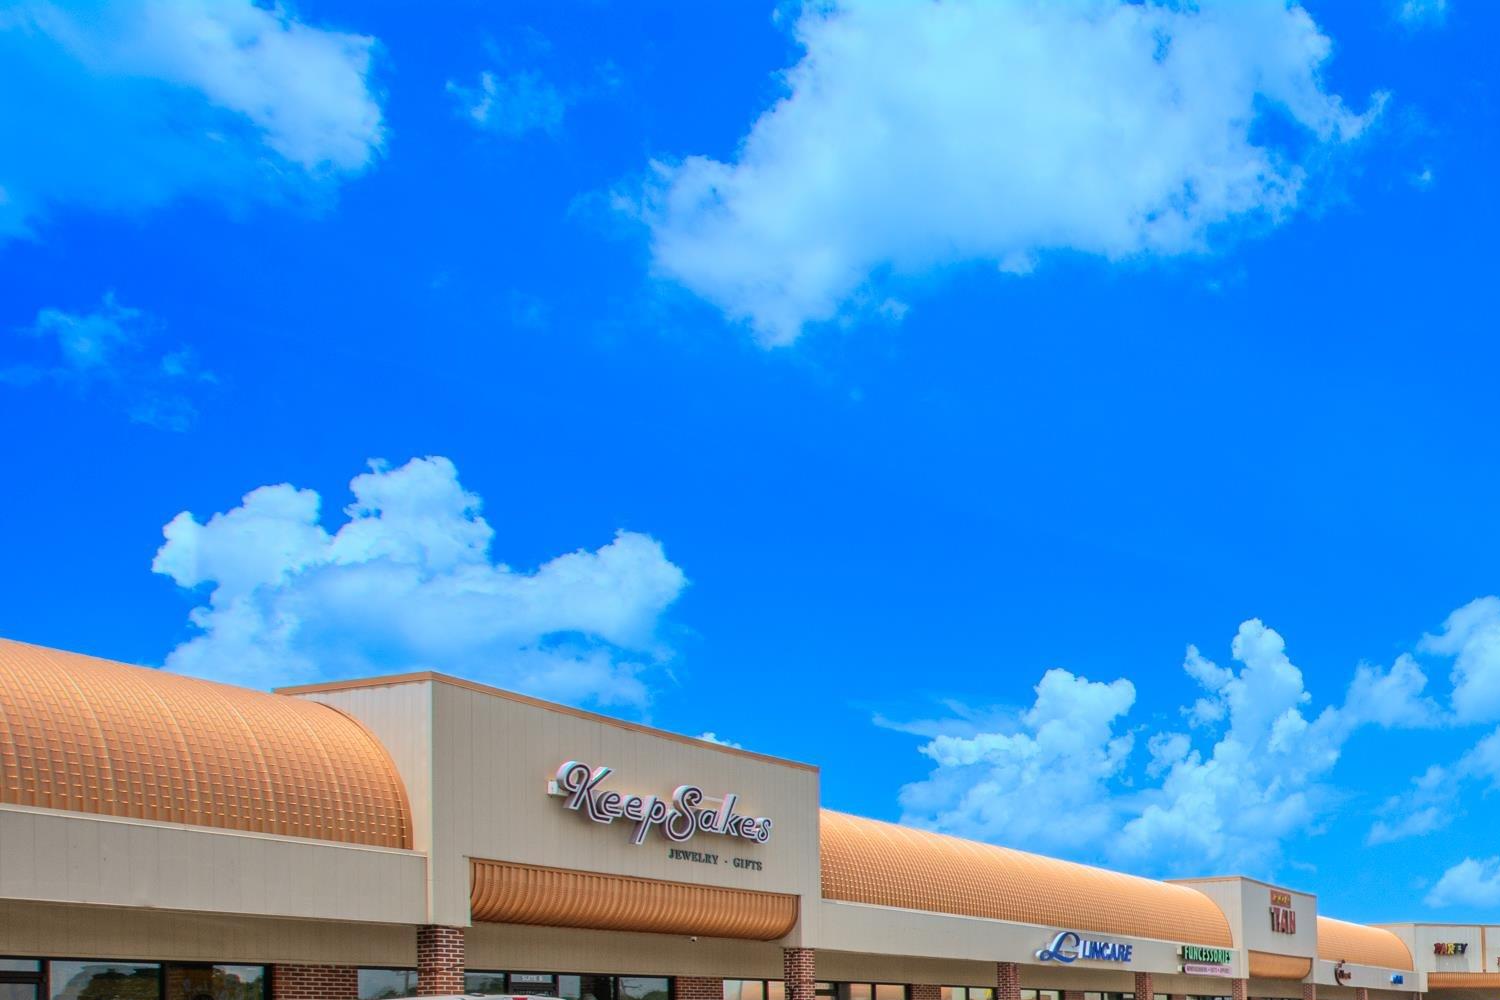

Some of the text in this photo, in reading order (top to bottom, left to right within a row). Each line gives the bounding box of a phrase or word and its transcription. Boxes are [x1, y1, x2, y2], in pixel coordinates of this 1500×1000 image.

[556, 761, 772, 845] KeepSakes
[668, 848, 762, 871] JEWELRY GIFTS
[1269, 906, 1296, 935] TAN
[1081, 940, 1132, 962] LINCARE
[1184, 946, 1232, 964] FUNCESSORIES
[1434, 943, 1468, 954] PARTY
